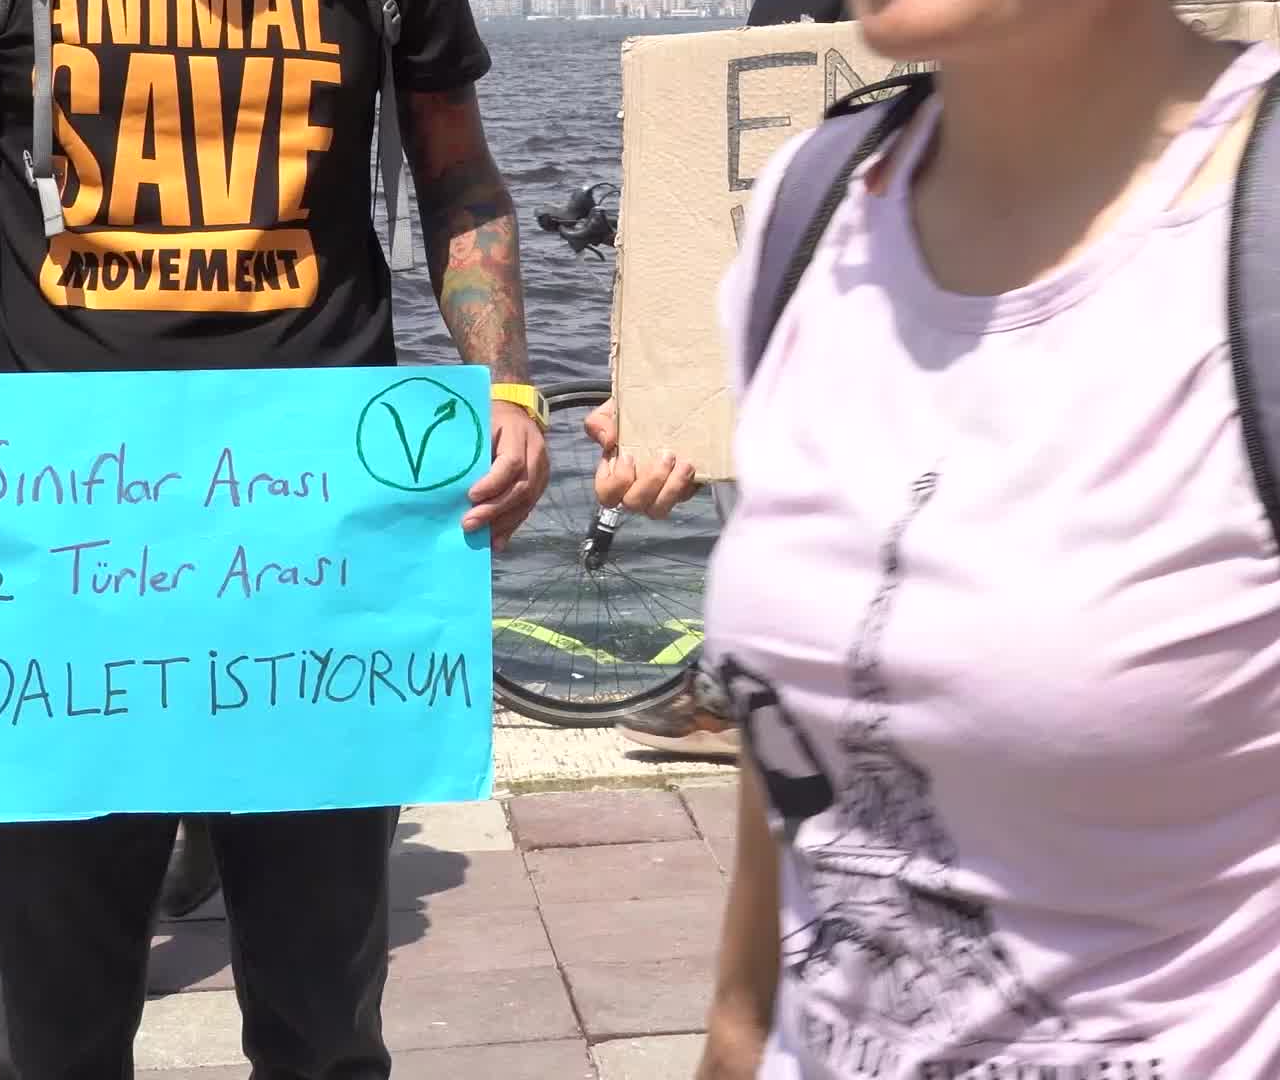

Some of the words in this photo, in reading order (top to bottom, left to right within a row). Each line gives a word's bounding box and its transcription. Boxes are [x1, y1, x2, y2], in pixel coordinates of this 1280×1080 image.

[32, 42, 342, 228] SAVE
[58, 248, 303, 293] MOVEMENT
[203, 446, 331, 508] Arası
[49, 538, 196, 598] Türler
[216, 544, 350, 599] Arası
